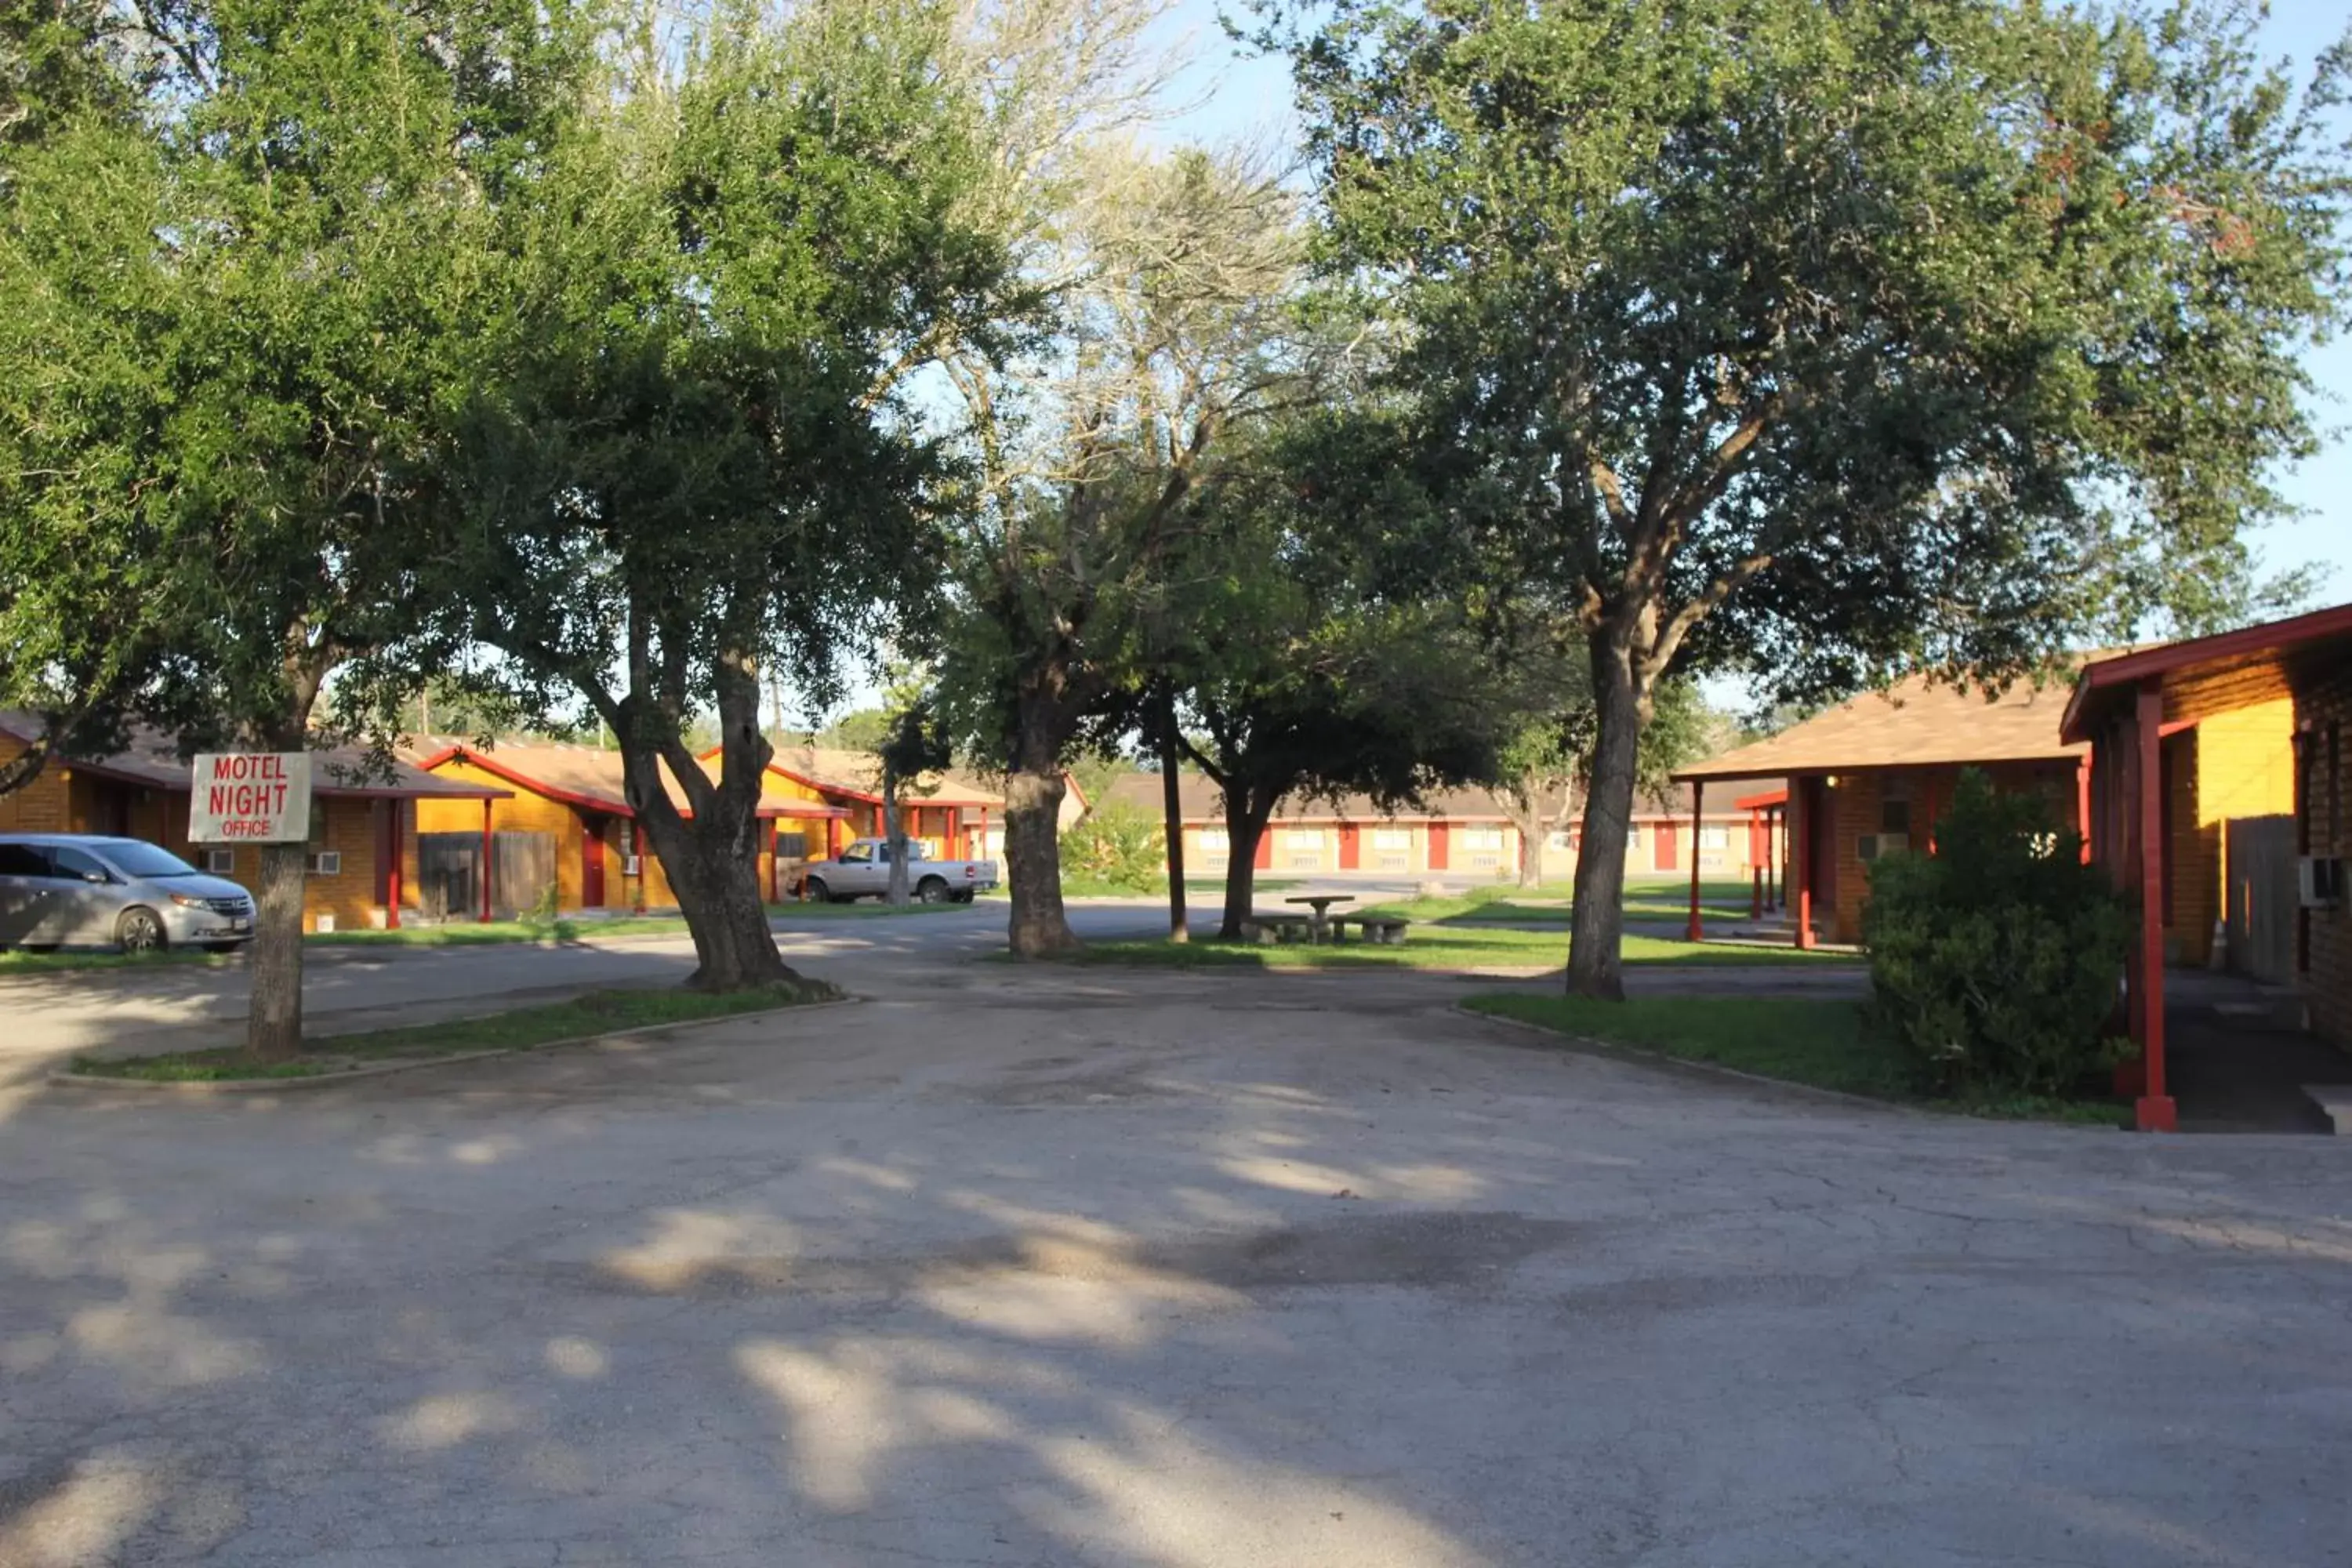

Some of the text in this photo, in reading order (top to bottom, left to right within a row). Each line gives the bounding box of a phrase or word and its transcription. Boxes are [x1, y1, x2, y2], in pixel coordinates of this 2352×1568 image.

[214, 756, 287, 779] MOTEL
[209, 785, 287, 815] NIGHT
[222, 820, 270, 836] OFFICE
